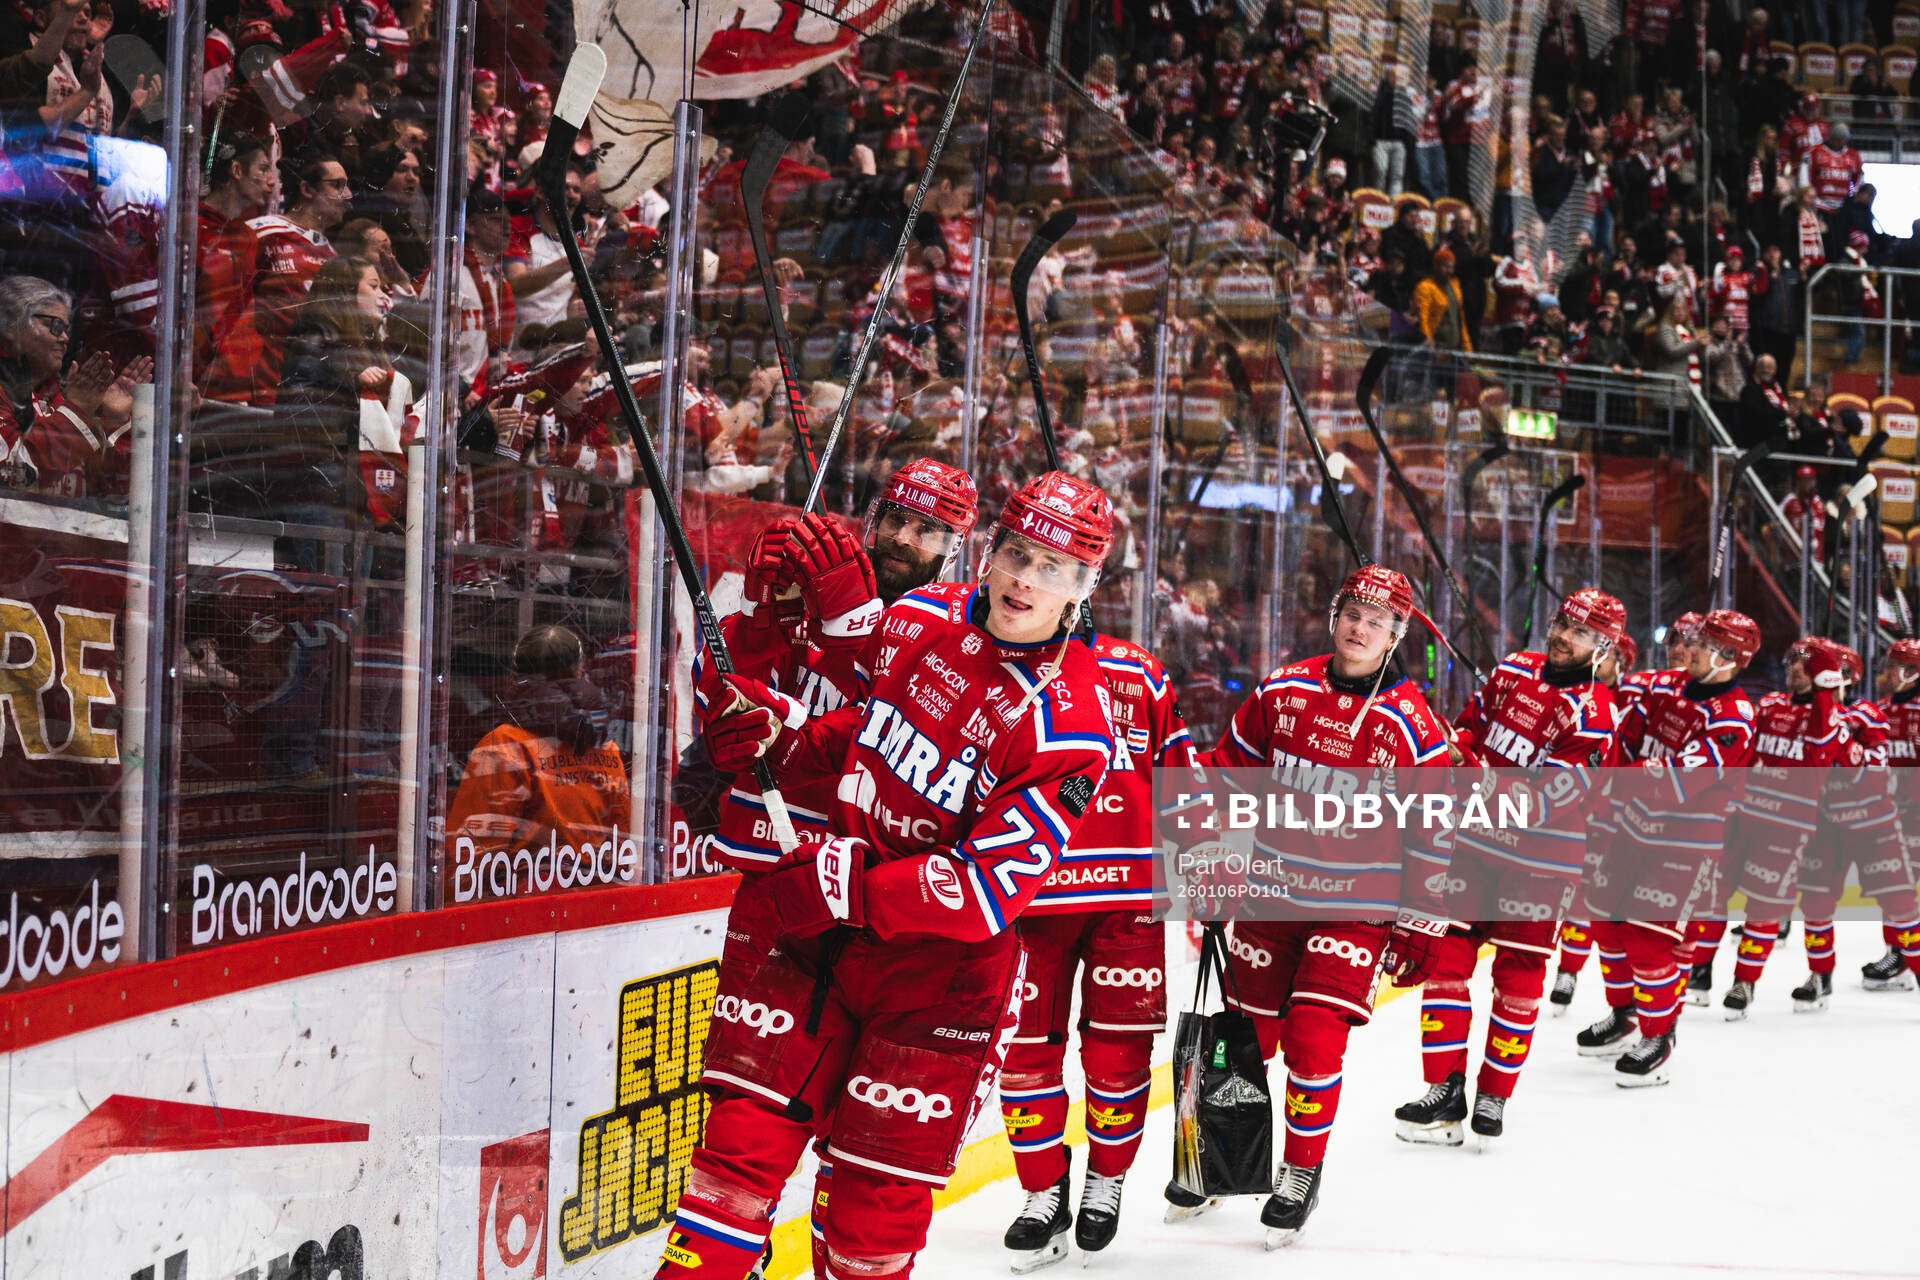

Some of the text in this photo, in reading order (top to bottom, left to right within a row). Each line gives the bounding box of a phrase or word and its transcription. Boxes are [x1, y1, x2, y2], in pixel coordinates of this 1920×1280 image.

[906, 487, 937, 508] LILIUM
[1034, 518, 1072, 547] LILIUM
[919, 583, 948, 595] SCA
[698, 609, 729, 676] BAUE
[921, 651, 970, 693] HIGHCON
[1130, 650, 1153, 669] SCA
[1285, 666, 1310, 676] SCA
[922, 684, 953, 713] SAXNÄS
[1050, 680, 1073, 712] SCA
[1113, 681, 1143, 697] LILIUM
[916, 694, 945, 721] GÄRDEN
[1313, 715, 1352, 733] HIGHCO
[1411, 711, 1430, 740] SCA
[858, 697, 977, 815] IMRÅ
[1320, 744, 1351, 759] GÄRDEN
[1323, 737, 1354, 752] SAXNÄS
[455, 824, 638, 902] Brandcode
[971, 805, 1053, 897] 72
[191, 844, 397, 945] Brandcode
[1399, 912, 1449, 937] BAU
[1307, 935, 1373, 967] coop
[1092, 966, 1163, 992] coop
[714, 993, 794, 1038] coop
[932, 1026, 991, 1043] BAUER
[847, 1074, 953, 1124] coop
[832, 1254, 873, 1272] BAUER
